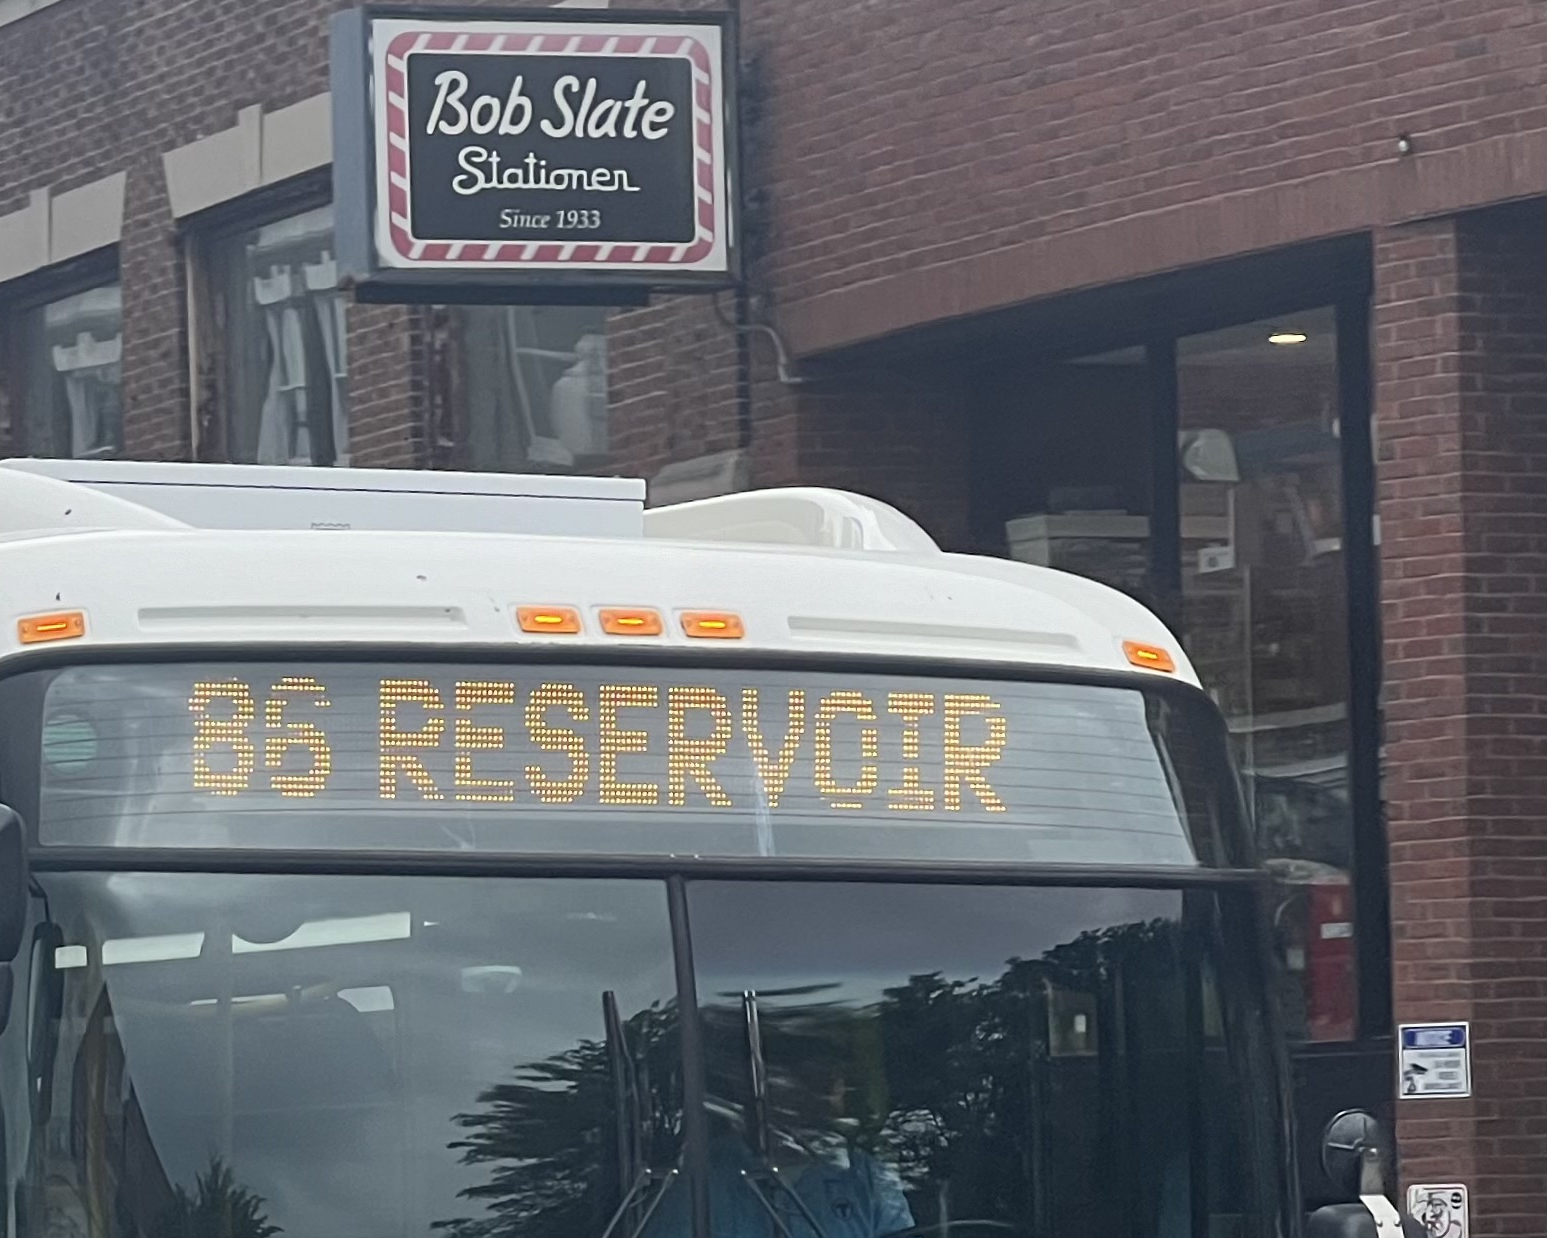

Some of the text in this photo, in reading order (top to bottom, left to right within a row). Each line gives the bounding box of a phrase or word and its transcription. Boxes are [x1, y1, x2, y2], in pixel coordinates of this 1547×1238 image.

[426, 70, 675, 139] Bob Slate
[452, 146, 641, 195] Stationer
[500, 208, 601, 229] Since 1933
[188, 676, 1006, 812] 86 RESERVOIR
